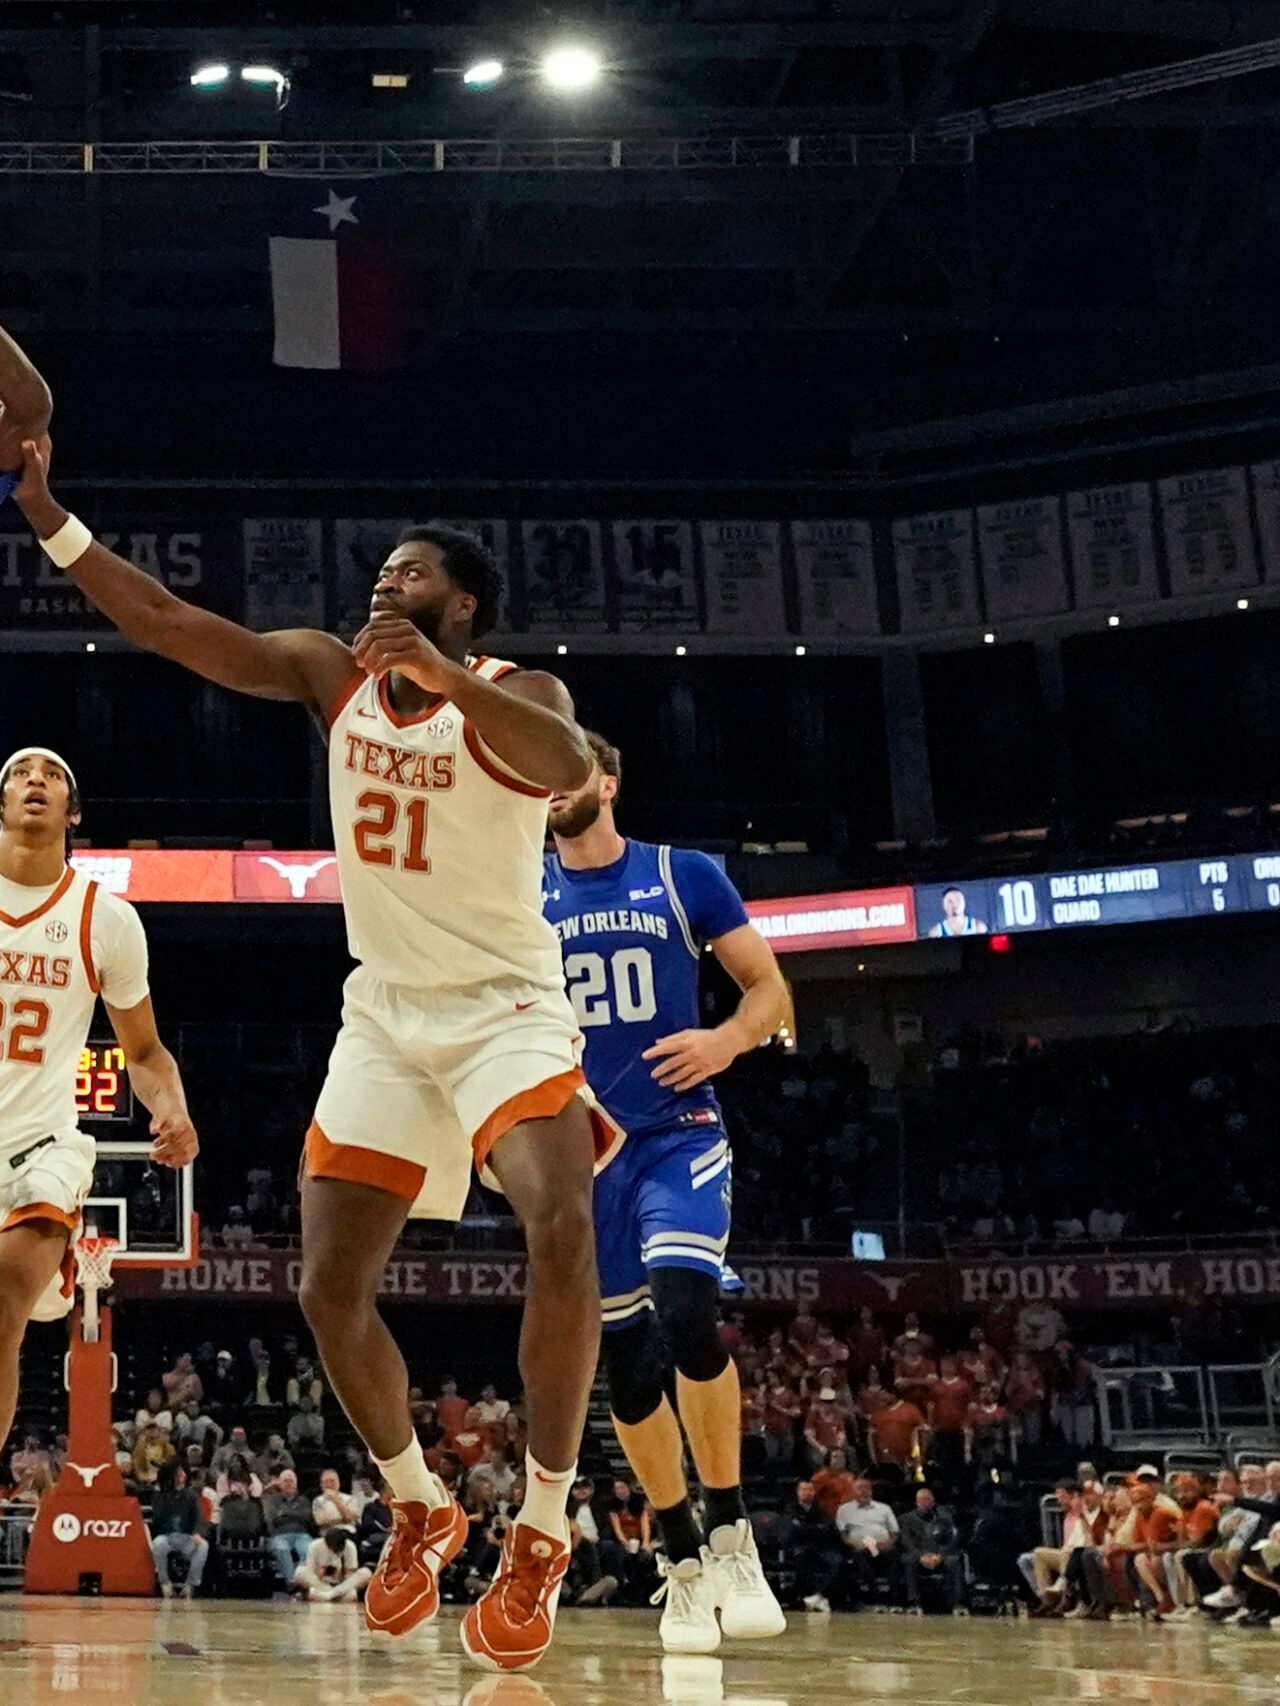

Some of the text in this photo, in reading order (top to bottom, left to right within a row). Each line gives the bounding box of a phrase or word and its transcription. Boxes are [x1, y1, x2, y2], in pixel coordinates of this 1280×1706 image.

[344, 730, 456, 792] TEXAS
[352, 787, 432, 876] 21
[1105, 867, 1160, 894] HUNTER
[1199, 861, 1230, 885] PTS
[998, 880, 1038, 927] 10
[1053, 899, 1102, 925] GUARD
[550, 909, 668, 943] EW ORLEANS
[564, 946, 657, 1028] 20
[160, 1259, 272, 1293] HOME
[376, 1261, 427, 1296] HE
[441, 1261, 528, 1297] TEX
[959, 1264, 1080, 1302] HOOK
[83, 1519, 132, 1538] razr
